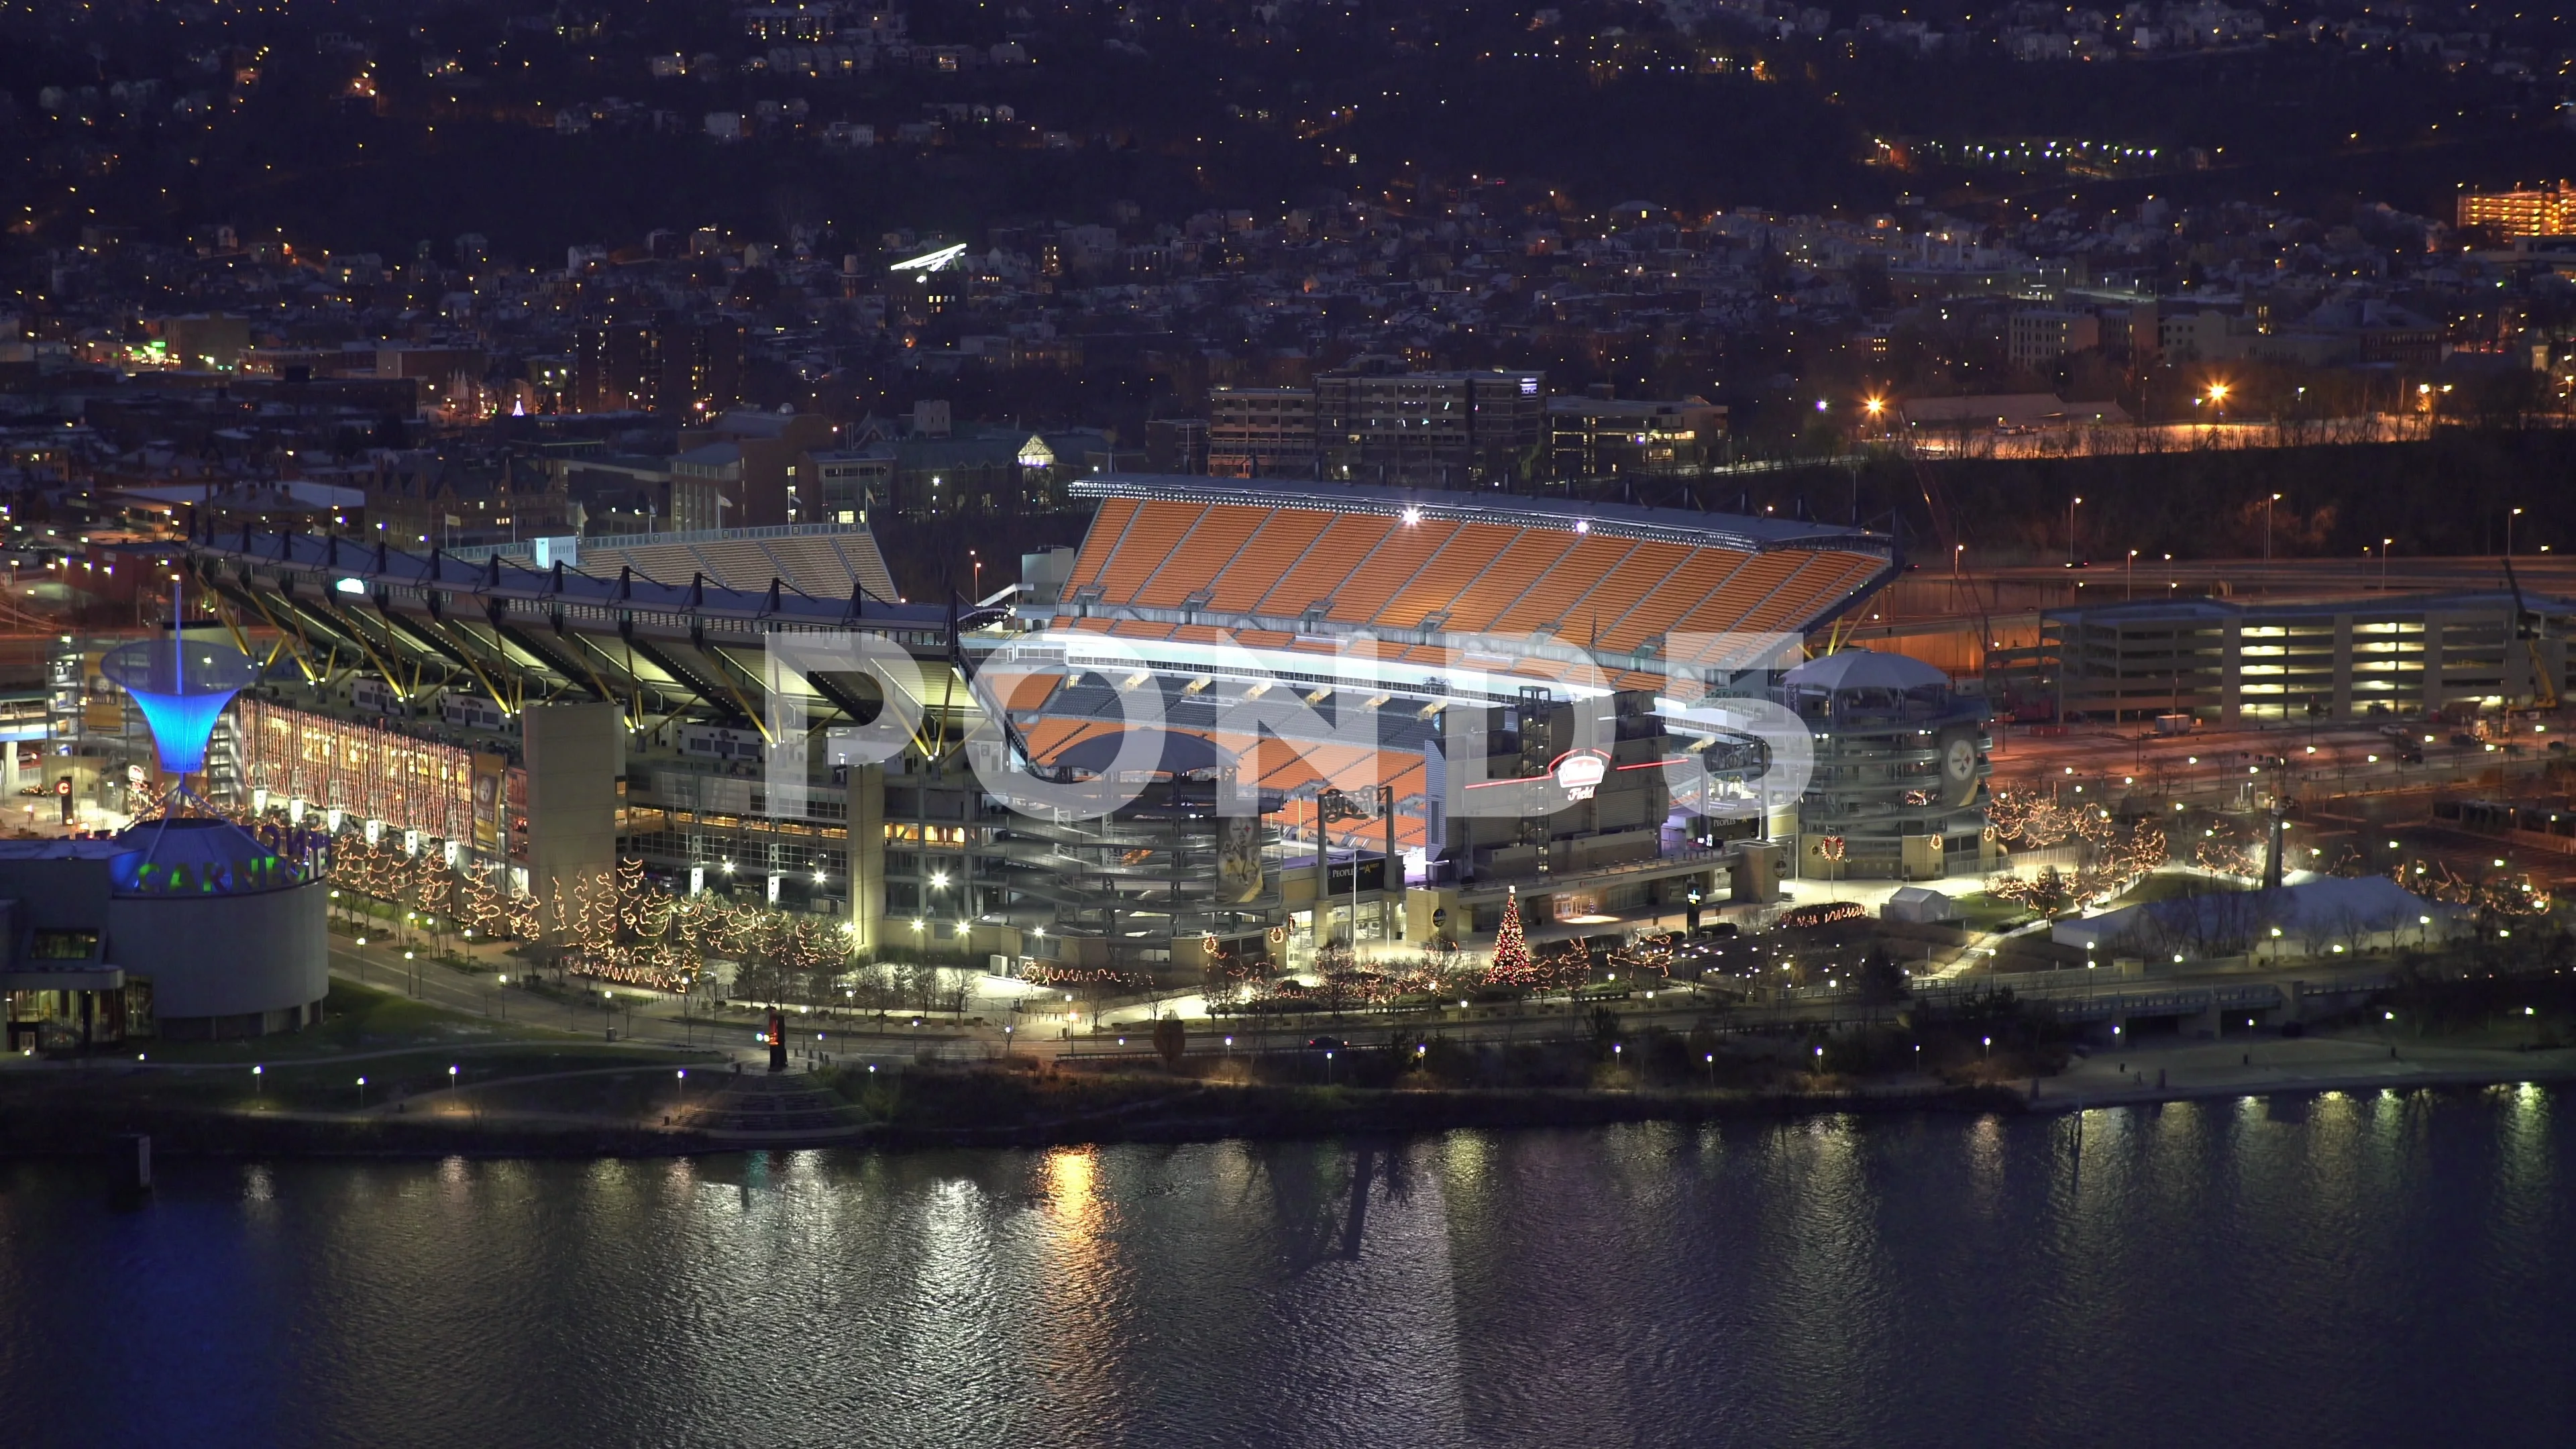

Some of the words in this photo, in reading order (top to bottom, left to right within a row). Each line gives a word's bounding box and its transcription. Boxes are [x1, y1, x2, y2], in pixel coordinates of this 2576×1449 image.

[1568, 786, 1595, 801] Field
[477, 807, 494, 822] UNITE
[138, 847, 327, 893] CARNEGIE
[1332, 867, 1356, 878] PEOPLE
